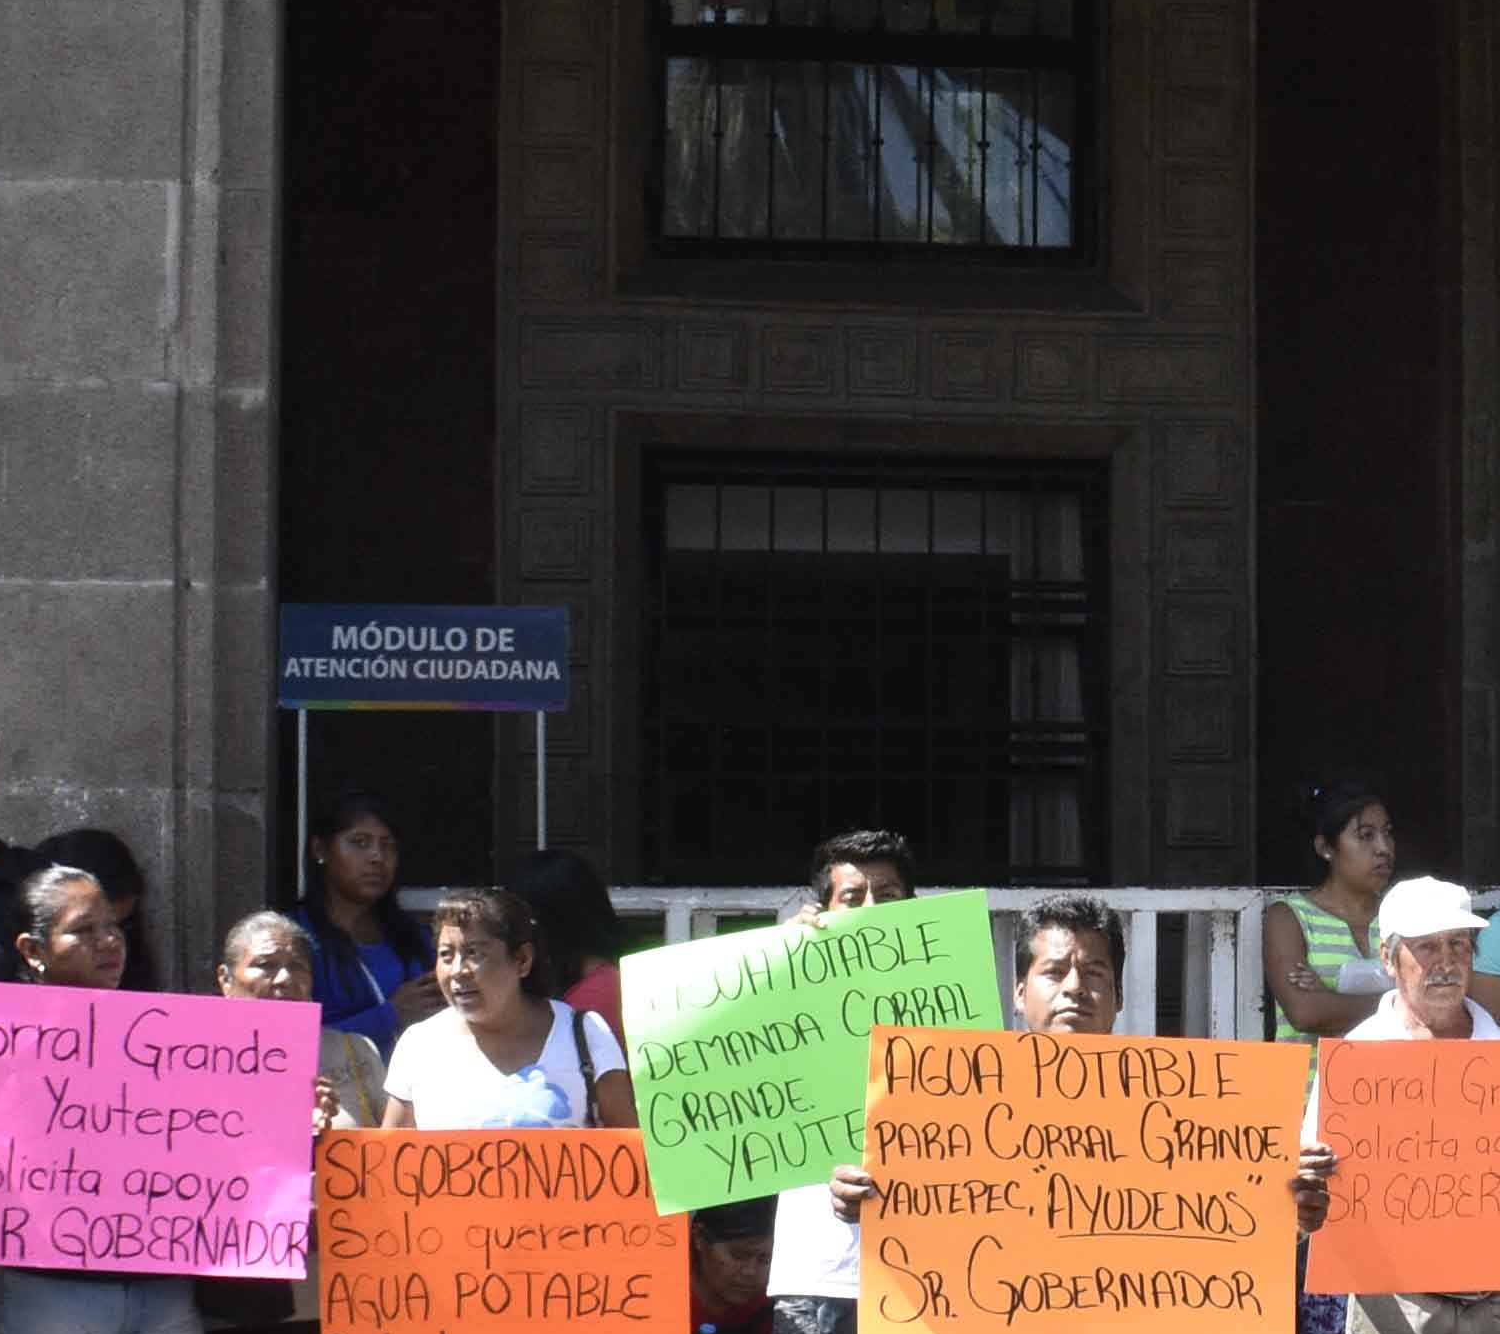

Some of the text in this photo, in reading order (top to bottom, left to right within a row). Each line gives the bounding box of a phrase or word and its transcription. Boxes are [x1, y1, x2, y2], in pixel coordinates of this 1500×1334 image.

[284, 654, 561, 681] ATENCIÓN CIUDADANA
[331, 621, 515, 652] MÓDULO DE
[124, 1007, 289, 1082] Grande
[637, 982, 982, 1082] DEMANDA CORRAL
[884, 1032, 1241, 1100] AGUA POTABLE
[1324, 1042, 1438, 1107] Corral
[43, 1074, 246, 1153] Yautepec
[873, 1100, 1290, 1169] PARA CORRAL GRANDE.
[1323, 1112, 1459, 1163] Solicita
[325, 1138, 388, 1202] SR
[704, 1108, 866, 1195] YAUTE
[122, 1166, 250, 1219] apoyo
[1326, 1172, 1369, 1224] SR
[50, 1205, 313, 1269] GOBERNADOR
[329, 1208, 679, 1270] Solo queremos
[326, 1267, 653, 1330] AGUA POTABLE
[967, 1235, 1263, 1326] GOBERNADOR
